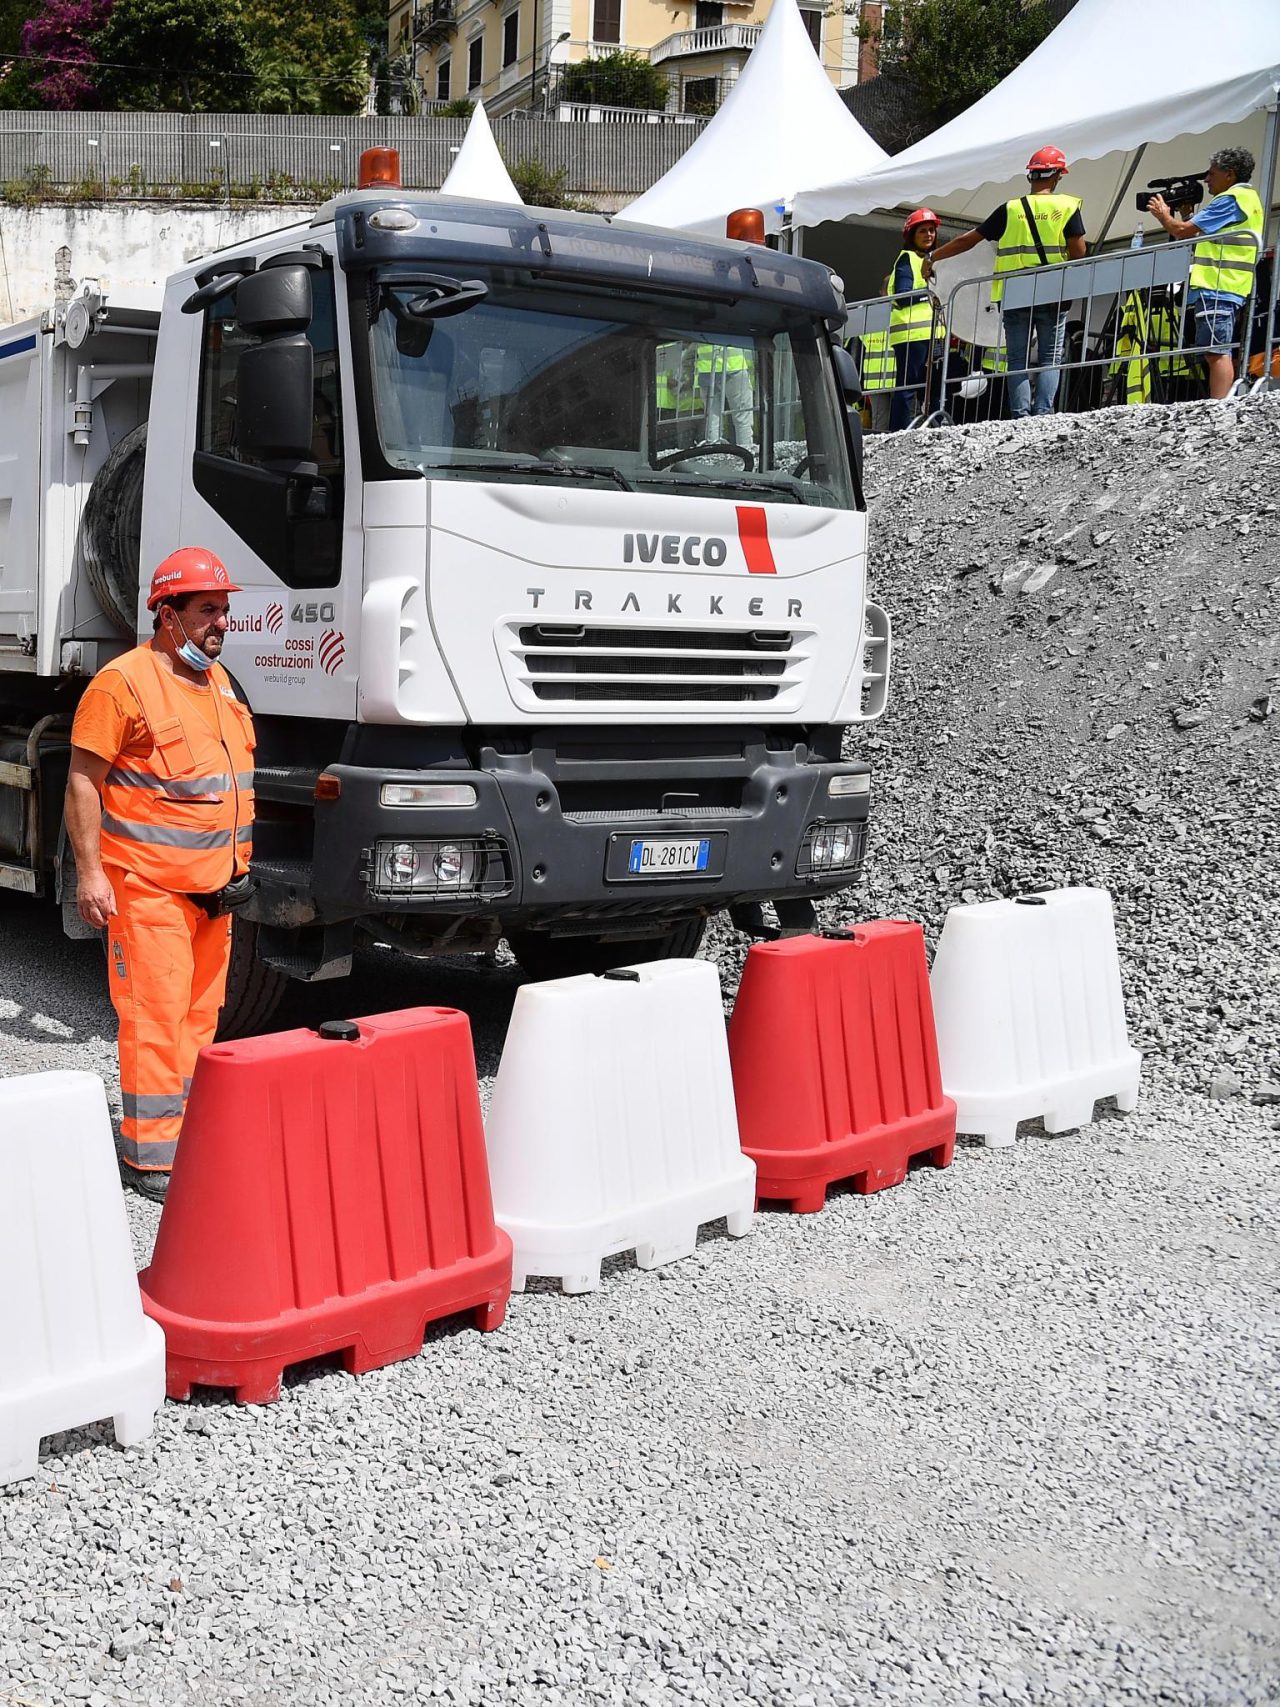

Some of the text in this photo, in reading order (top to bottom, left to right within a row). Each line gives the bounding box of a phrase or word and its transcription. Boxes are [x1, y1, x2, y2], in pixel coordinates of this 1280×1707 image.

[623, 533, 727, 567] IVECO
[154, 570, 183, 585] webuild
[526, 587, 803, 618] TRAKKER
[290, 602, 336, 624] 450
[224, 614, 262, 633] ebuild
[285, 636, 315, 652] cossi
[254, 653, 314, 670] costruzioni
[642, 845, 699, 867] DL 281CV
